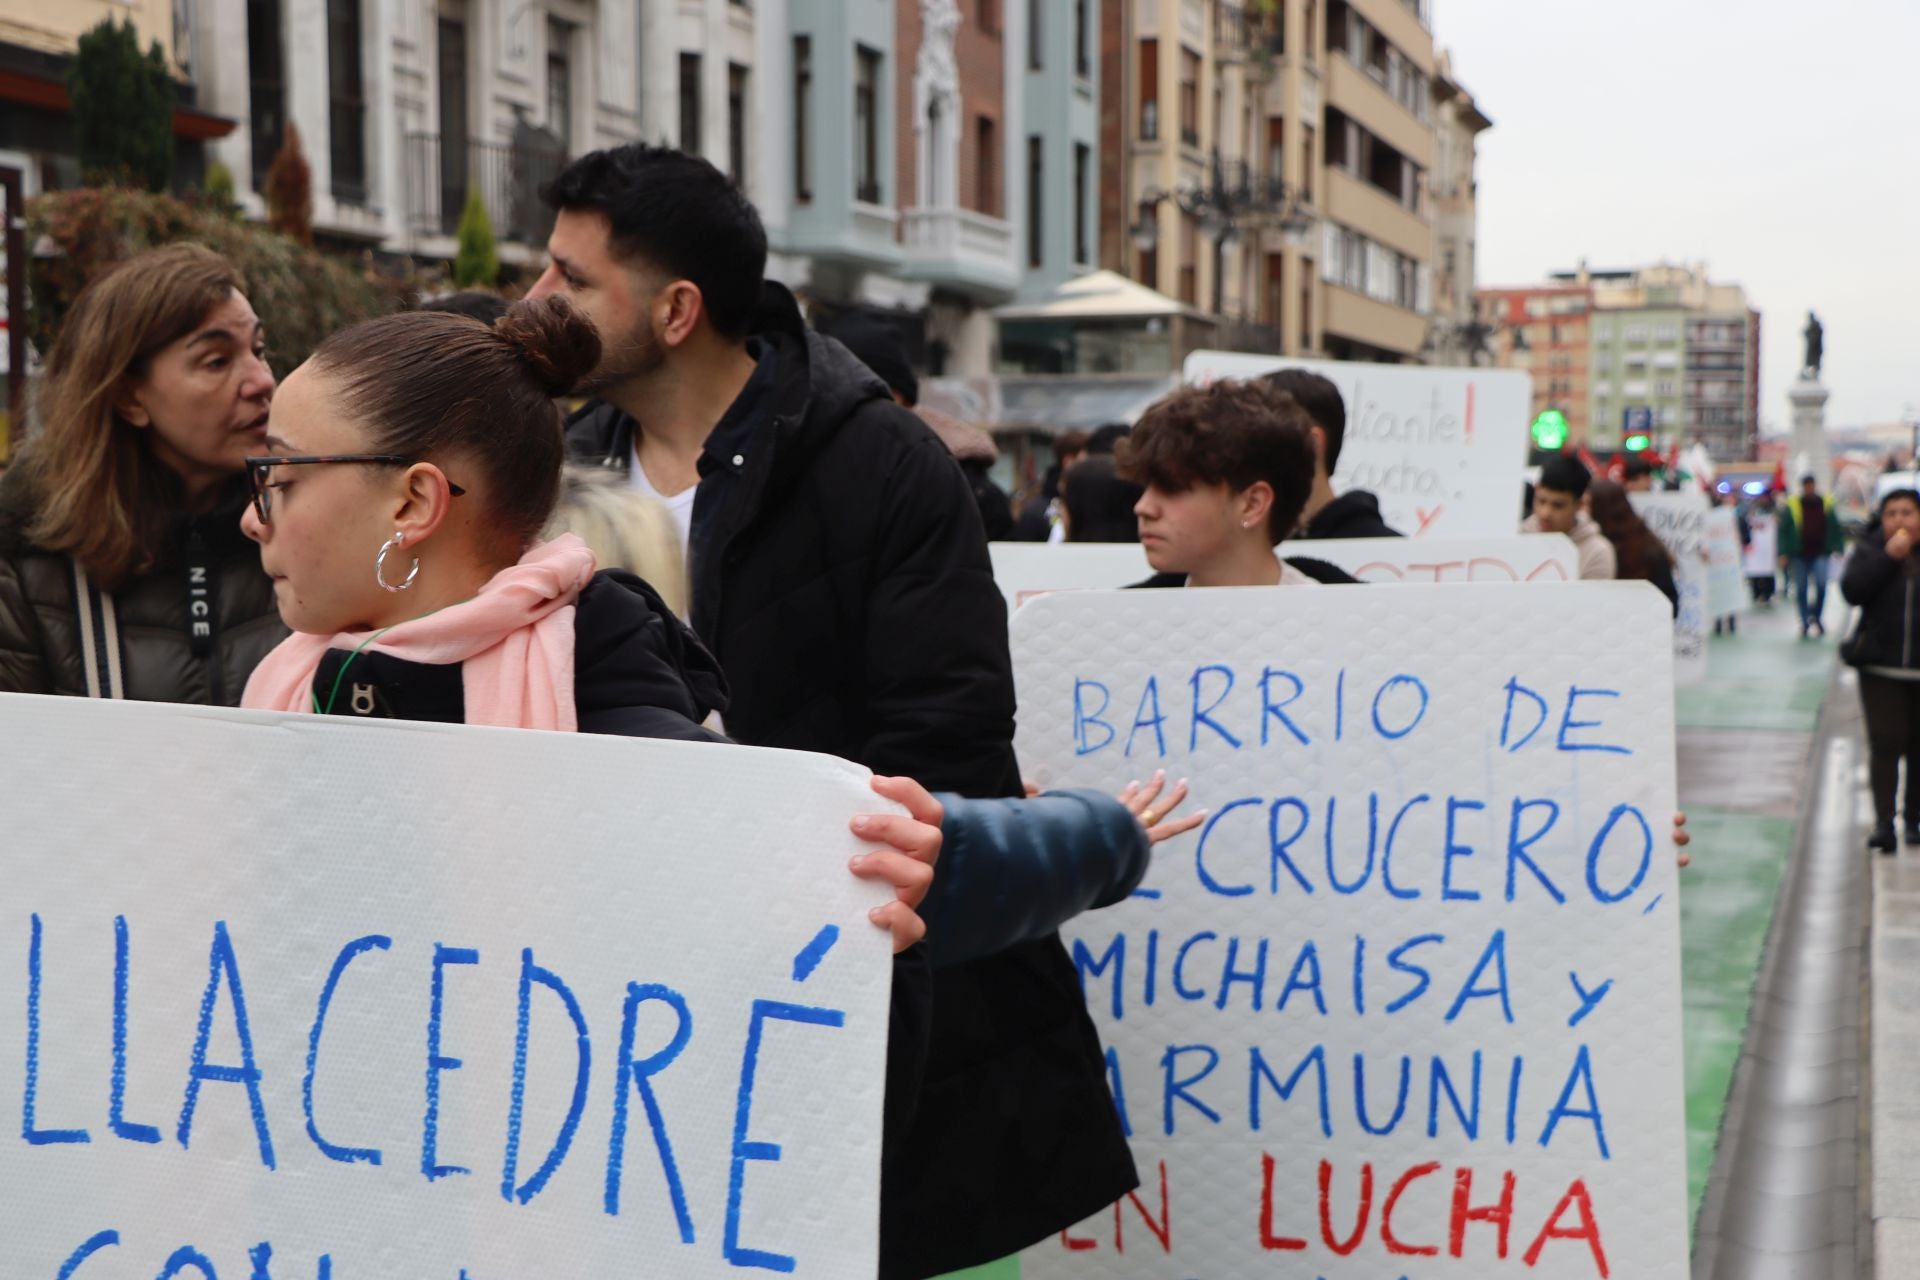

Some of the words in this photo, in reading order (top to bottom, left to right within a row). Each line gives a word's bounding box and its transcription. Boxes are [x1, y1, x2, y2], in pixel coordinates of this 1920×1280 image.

[190, 566, 210, 637] NICE
[1073, 664, 1430, 759] BARRIO
[1499, 675, 1633, 755] DE
[1195, 791, 1664, 914] CRUCERO,
[1072, 926, 1516, 1025] MICHAISA
[20, 911, 847, 1274] LLACEDRÉ
[1060, 1157, 1172, 1255] N
[1258, 1152, 1611, 1279] LUCHA
